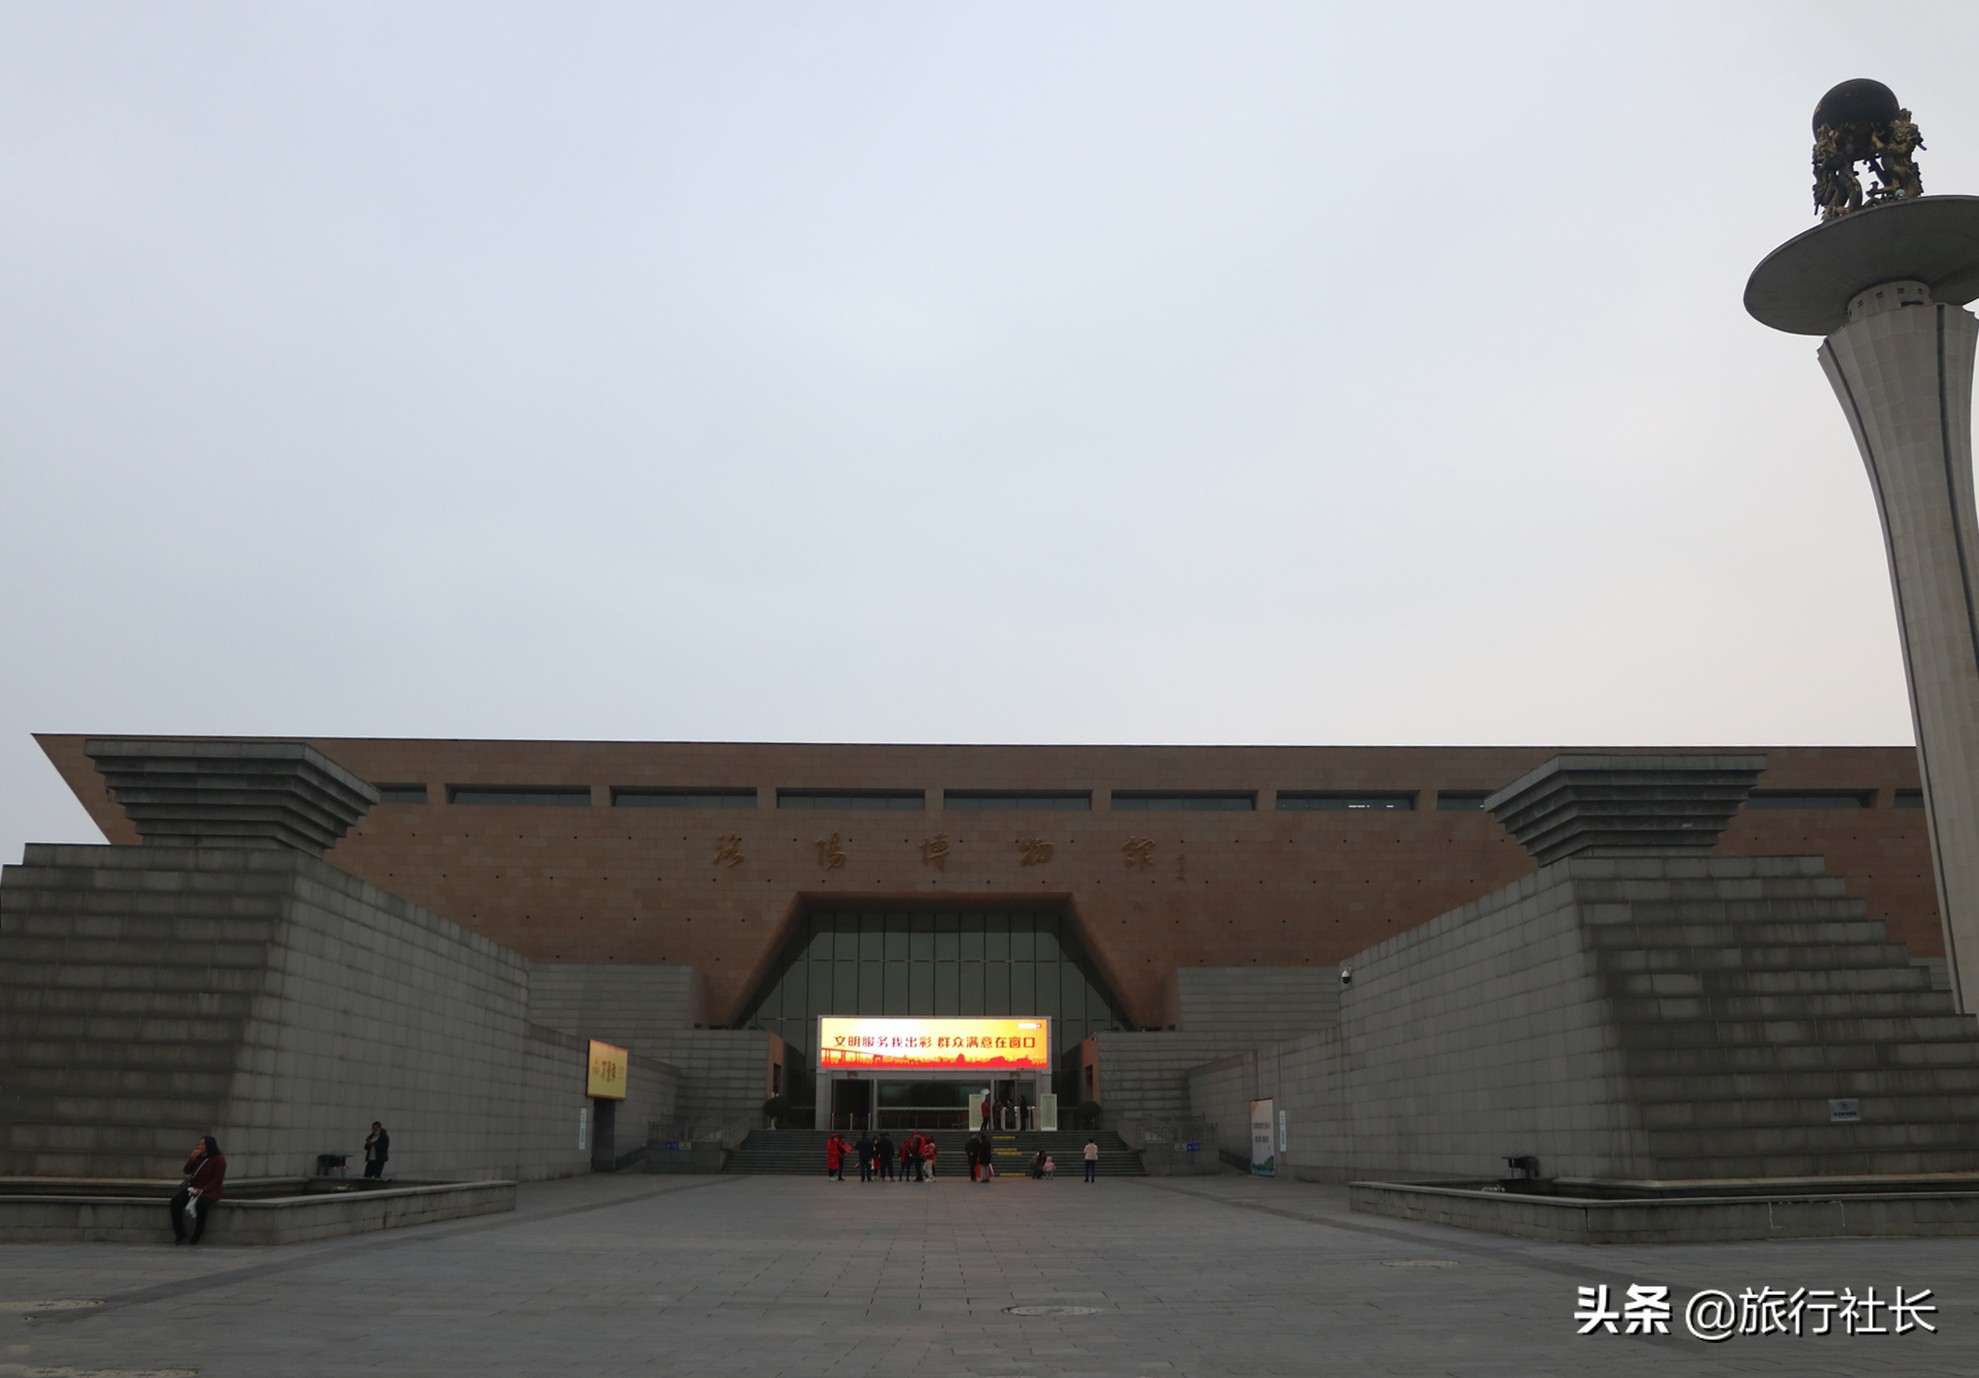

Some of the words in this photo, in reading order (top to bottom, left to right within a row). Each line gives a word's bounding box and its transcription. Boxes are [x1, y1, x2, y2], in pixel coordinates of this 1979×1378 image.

[834, 1035, 932, 1048] 文明服务我出彩
[938, 1036, 1036, 1048] 群众满意在窗口
